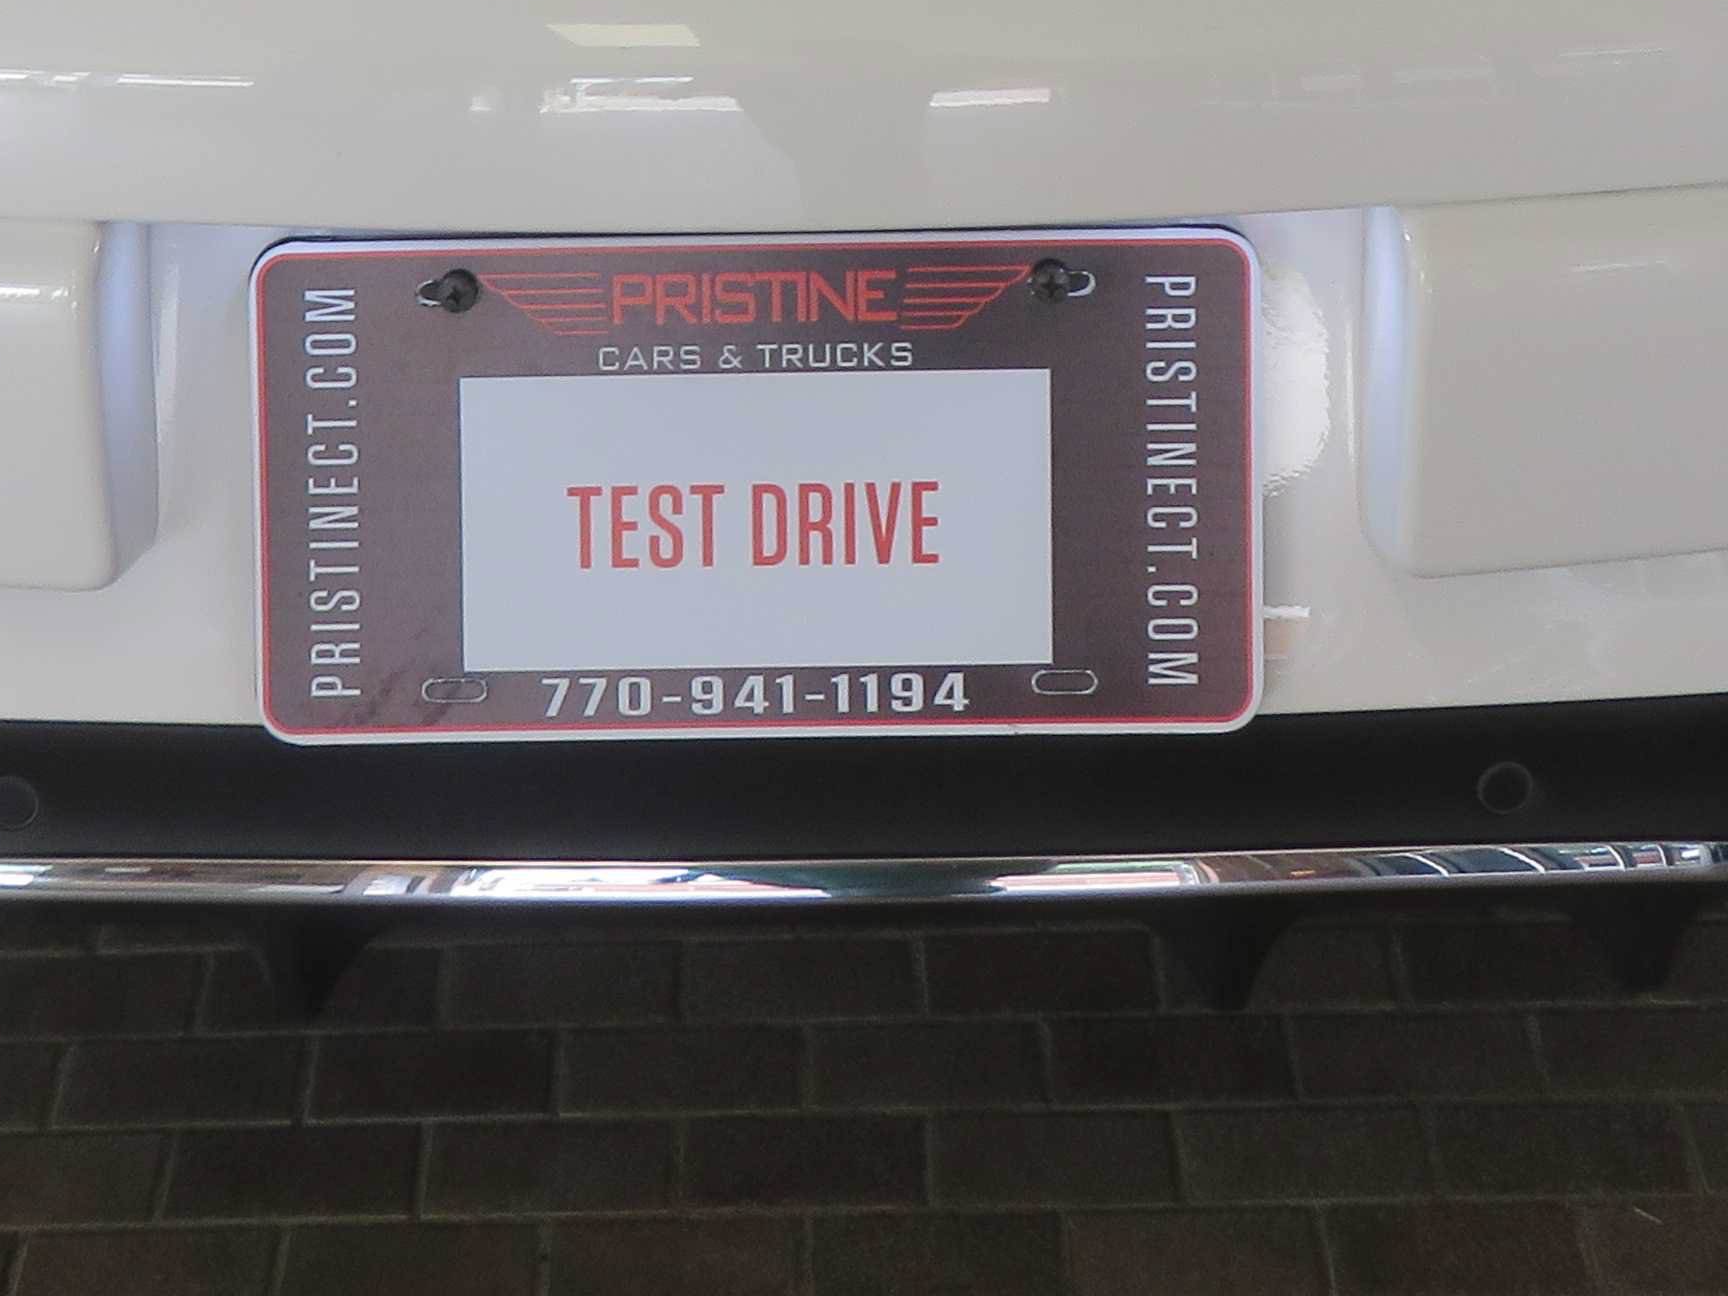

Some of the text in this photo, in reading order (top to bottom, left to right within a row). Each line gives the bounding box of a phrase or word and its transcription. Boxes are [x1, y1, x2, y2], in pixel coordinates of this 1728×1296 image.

[609, 268, 900, 326] PRISTINE
[597, 341, 914, 372] CARS & TRUCKS
[303, 287, 362, 700] PRISTINECT.COM
[1143, 274, 1200, 687] PRISTINECT.COM
[566, 480, 941, 570] TEST DRIVE
[540, 671, 972, 718] 770-941-1194
